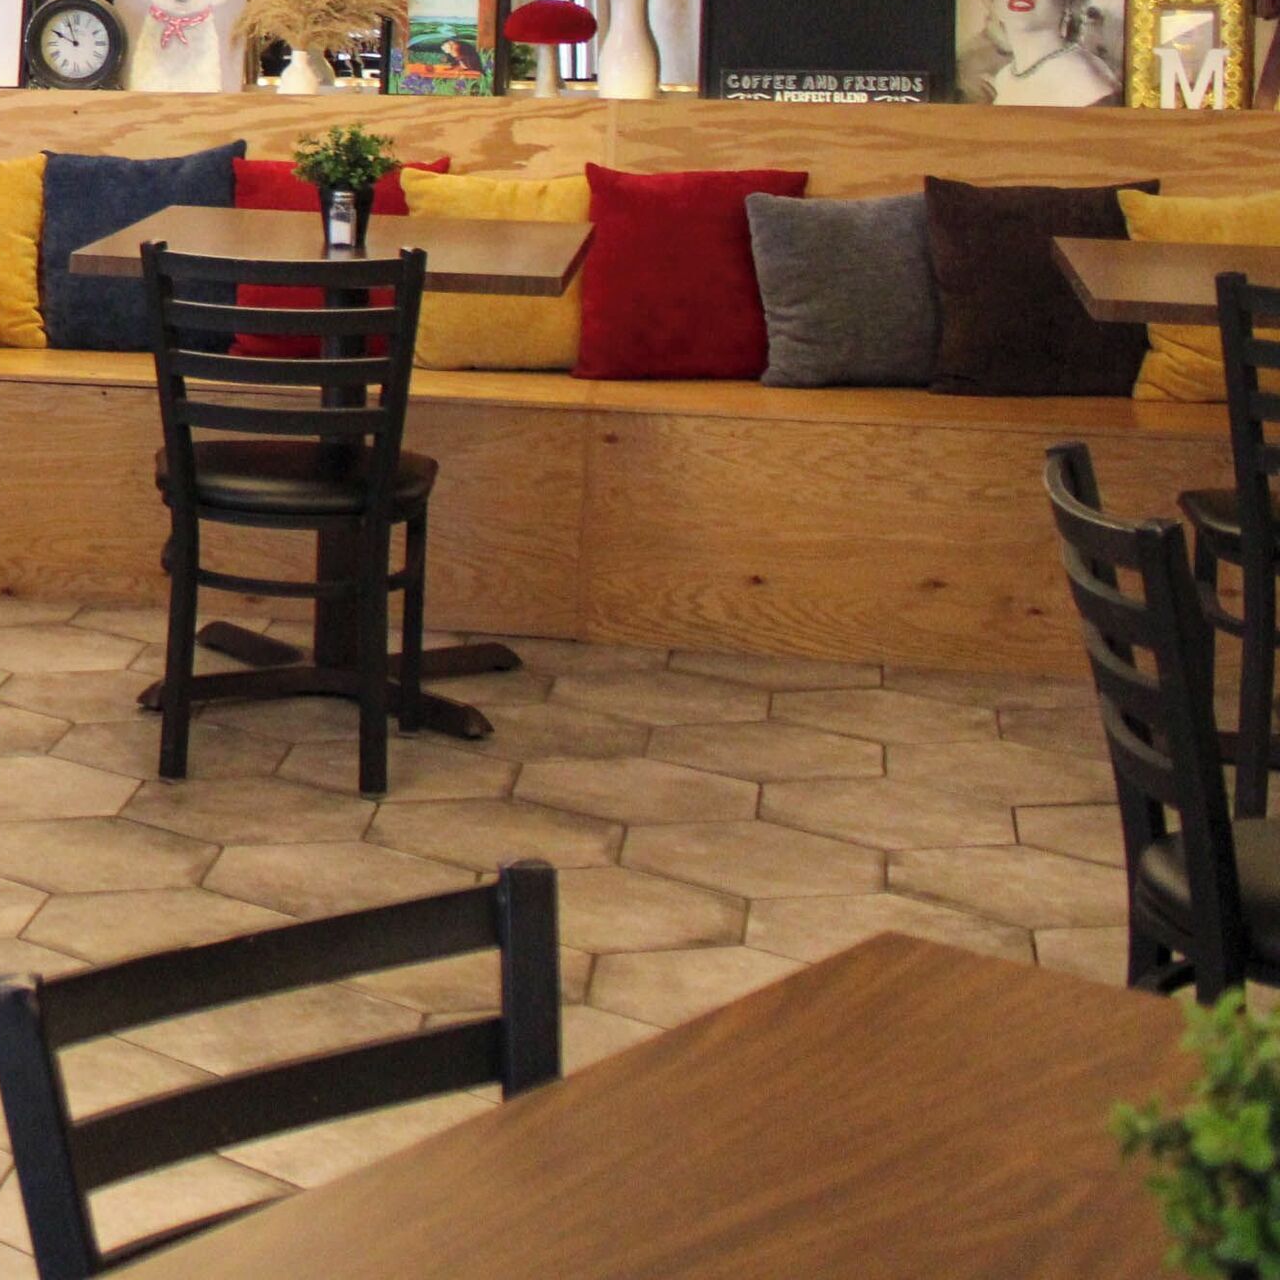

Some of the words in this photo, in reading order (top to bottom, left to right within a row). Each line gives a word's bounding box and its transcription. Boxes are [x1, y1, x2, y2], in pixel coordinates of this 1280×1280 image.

[726, 74, 797, 90] COFFEE
[802, 75, 838, 91] AND
[843, 76, 924, 92] FRIENDS
[1153, 48, 1231, 110] M
[774, 91, 783, 102] A
[784, 91, 831, 103] PERFECT
[833, 92, 869, 103] BLEND
